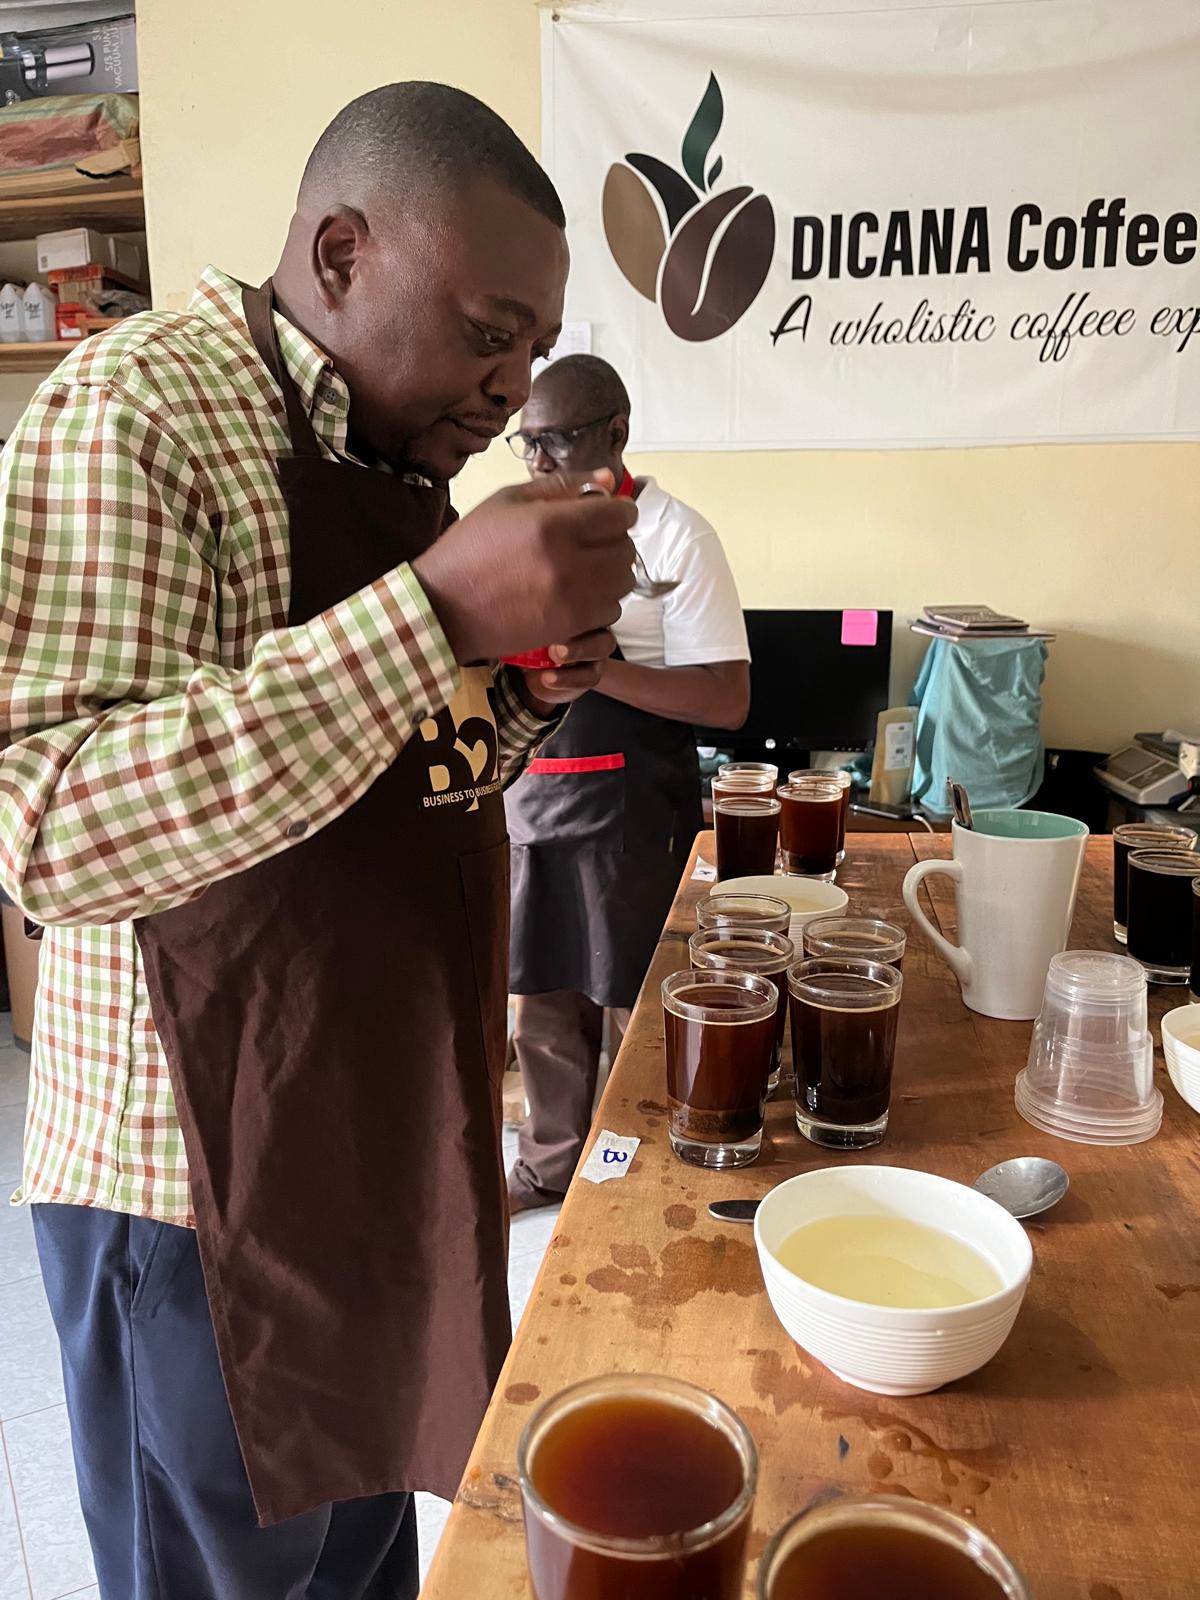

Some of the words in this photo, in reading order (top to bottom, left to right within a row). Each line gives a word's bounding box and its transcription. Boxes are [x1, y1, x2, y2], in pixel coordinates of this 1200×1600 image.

[112, 41, 122, 89] VACUUM
[791, 206, 991, 281] DICANA
[1007, 197, 1198, 273] Coffee
[769, 294, 812, 346] A
[829, 298, 996, 346] wholistic
[1010, 291, 1136, 363] coffeee
[423, 791, 464, 808] BUSINESS
[464, 789, 475, 800] TO
